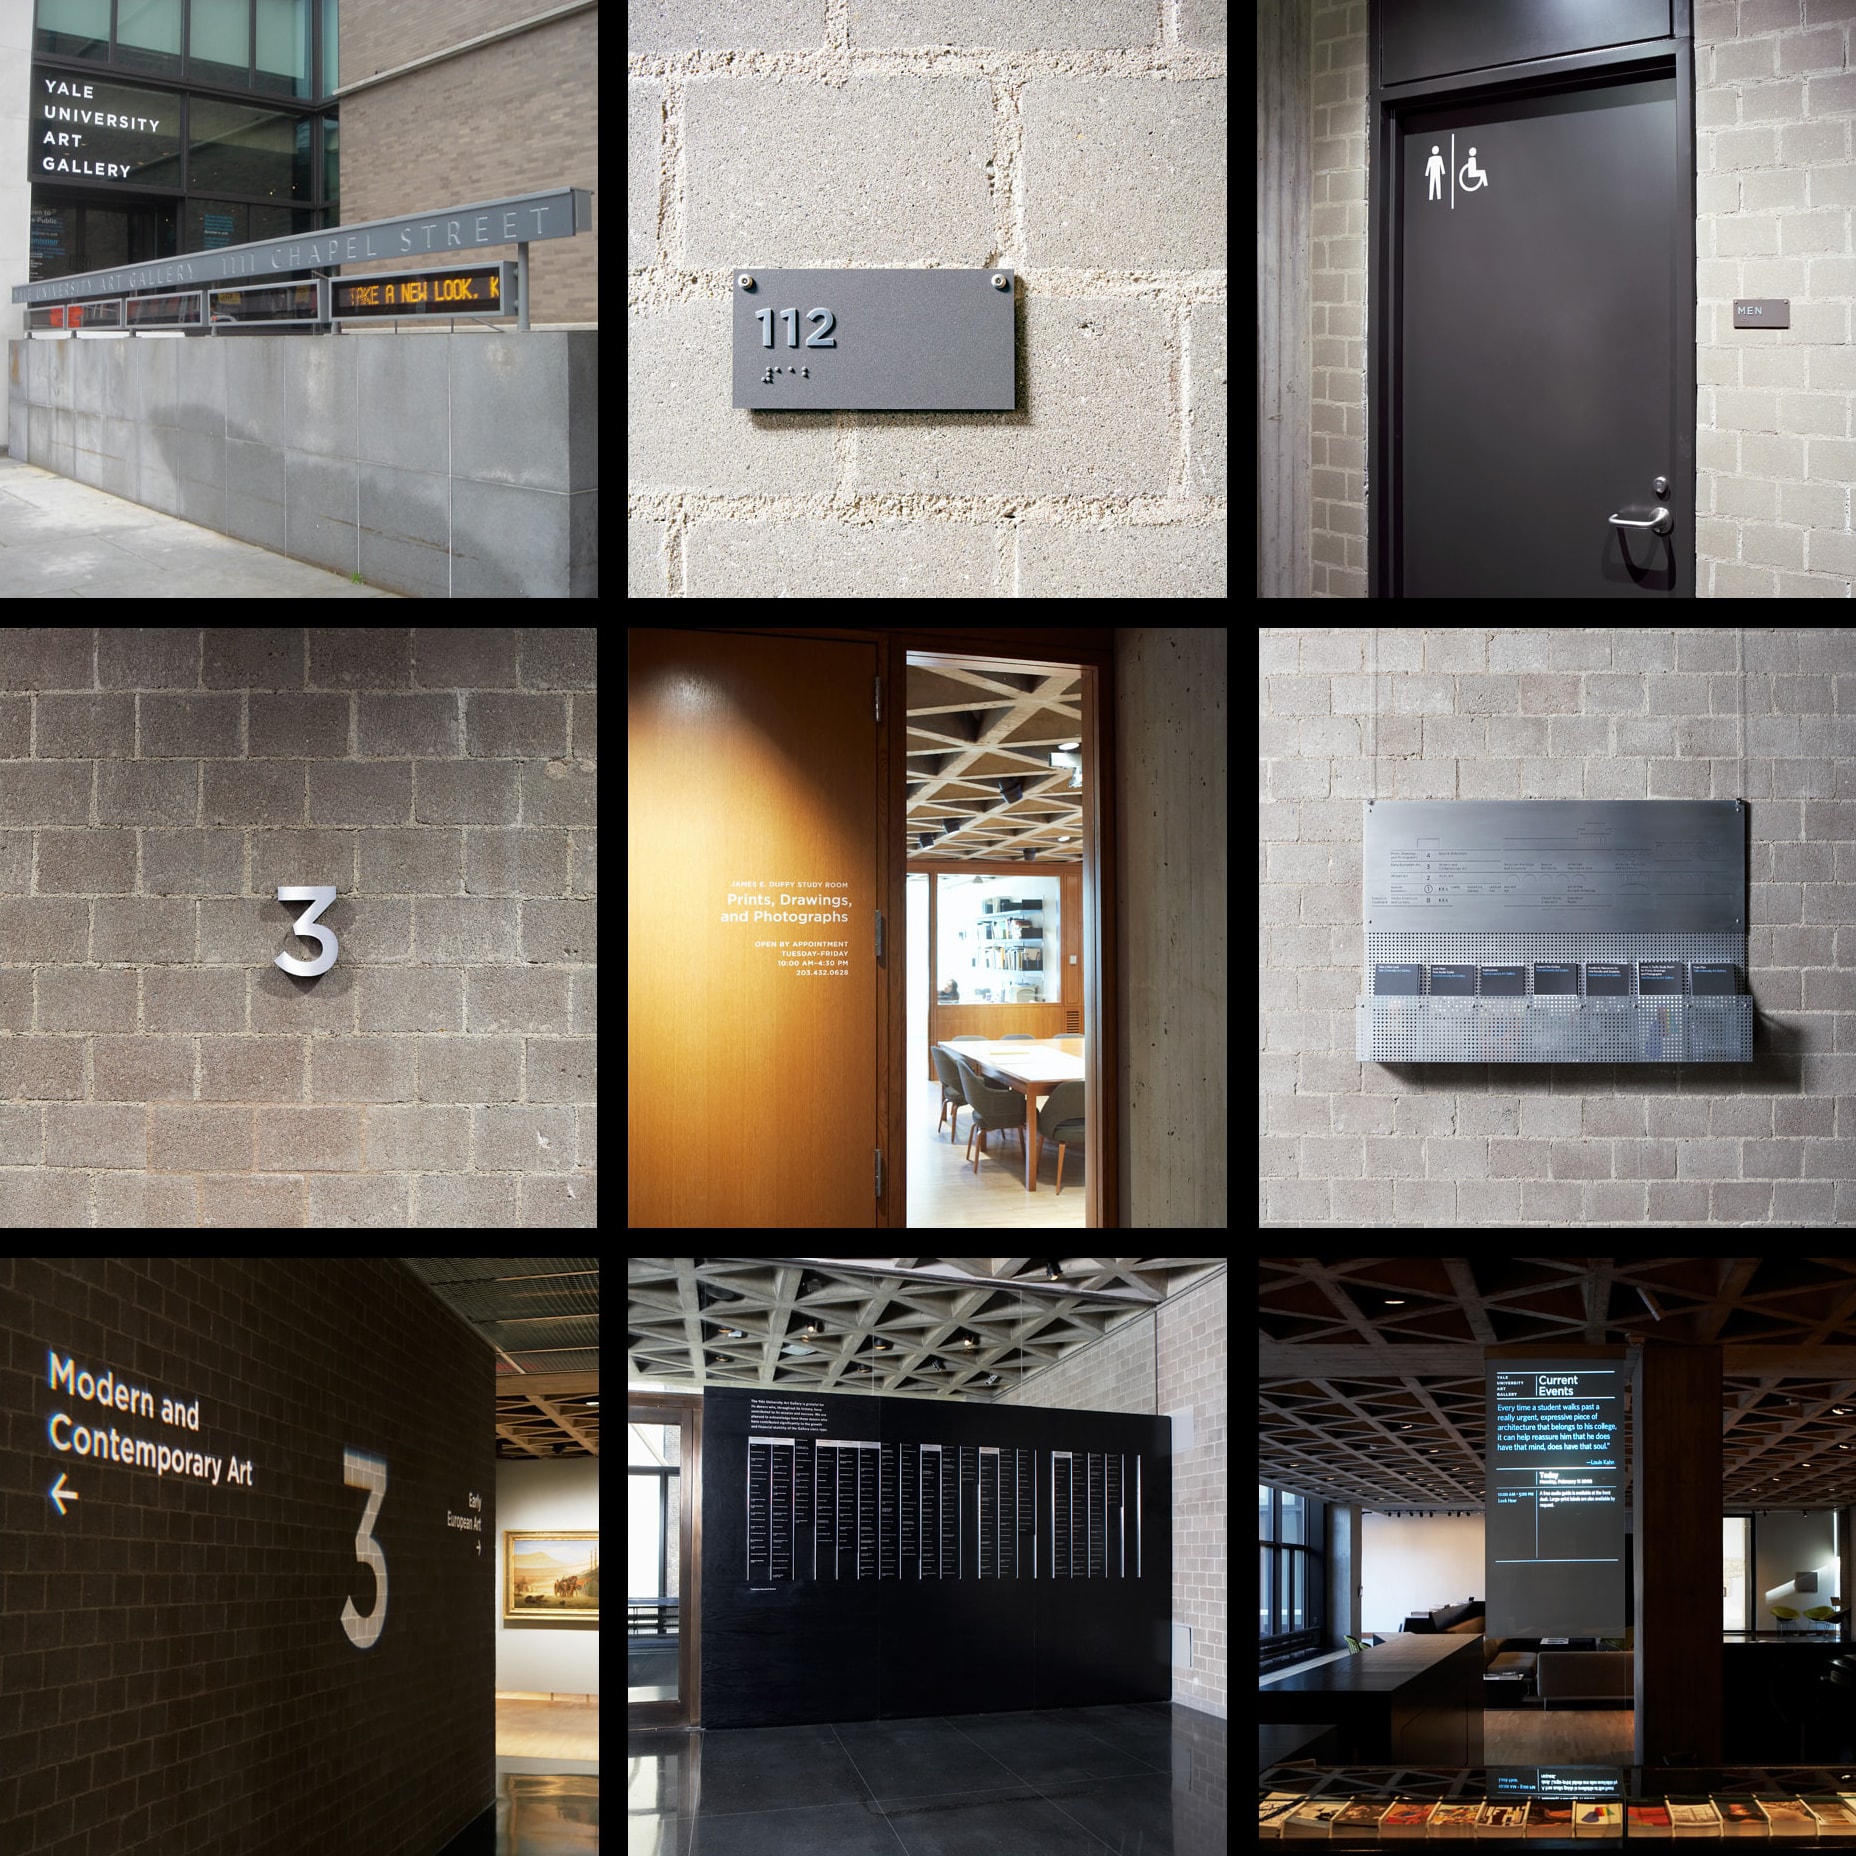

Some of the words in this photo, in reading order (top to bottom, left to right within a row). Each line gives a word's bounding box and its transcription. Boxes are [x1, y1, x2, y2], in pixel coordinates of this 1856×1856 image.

[45, 79, 94, 99] YALE
[44, 104, 160, 133] UNIVERSITY
[43, 130, 82, 148] ART
[42, 155, 131, 178] GALLERY
[129, 262, 193, 288] GALLERY
[271, 235, 376, 270] CHAPEL
[400, 206, 550, 253] STREET
[351, 284, 379, 306] TAKE
[385, 283, 395, 304] A
[401, 281, 428, 303] NEW
[434, 277, 479, 301] LOOK.
[1738, 306, 1763, 315] MEN
[755, 307, 836, 347] 112
[727, 893, 775, 908] Prints,
[780, 893, 853, 908] Drawings,
[720, 910, 749, 923] and
[754, 910, 849, 925] Photographs
[273, 885, 339, 977] 3
[1538, 1375, 1578, 1385] Current
[48, 1349, 154, 1419] Modern
[161, 1398, 199, 1432] and
[1538, 1386, 1574, 1397] Events
[1498, 1404, 1515, 1413] Every
[1562, 1403, 1580, 1411] walks
[1581, 1404, 1595, 1412] past
[1498, 1414, 1515, 1422] really
[1540, 1413, 1573, 1422] expressive
[1574, 1413, 1590, 1421] piece
[1591, 1412, 1598, 1420] of
[1537, 1423, 1550, 1431] that
[1551, 1423, 1575, 1432] belongs
[1584, 1422, 1593, 1430] his
[1516, 1433, 1530, 1442] help
[1560, 1432, 1572, 1440] him
[1573, 1432, 1586, 1440] that
[1586, 1432, 1595, 1440] he
[1596, 1432, 1611, 1440] does
[48, 1413, 222, 1486] Contemporary
[227, 1455, 253, 1487] Art
[1497, 1443, 1513, 1451] have
[1514, 1443, 1527, 1451] that
[1547, 1442, 1563, 1450] does
[1564, 1442, 1579, 1450] have
[1579, 1442, 1592, 1450] that
[1539, 1471, 1559, 1480] Today
[447, 1510, 473, 1531] European
[473, 1515, 482, 1532] Art
[340, 1448, 388, 1649] 3
